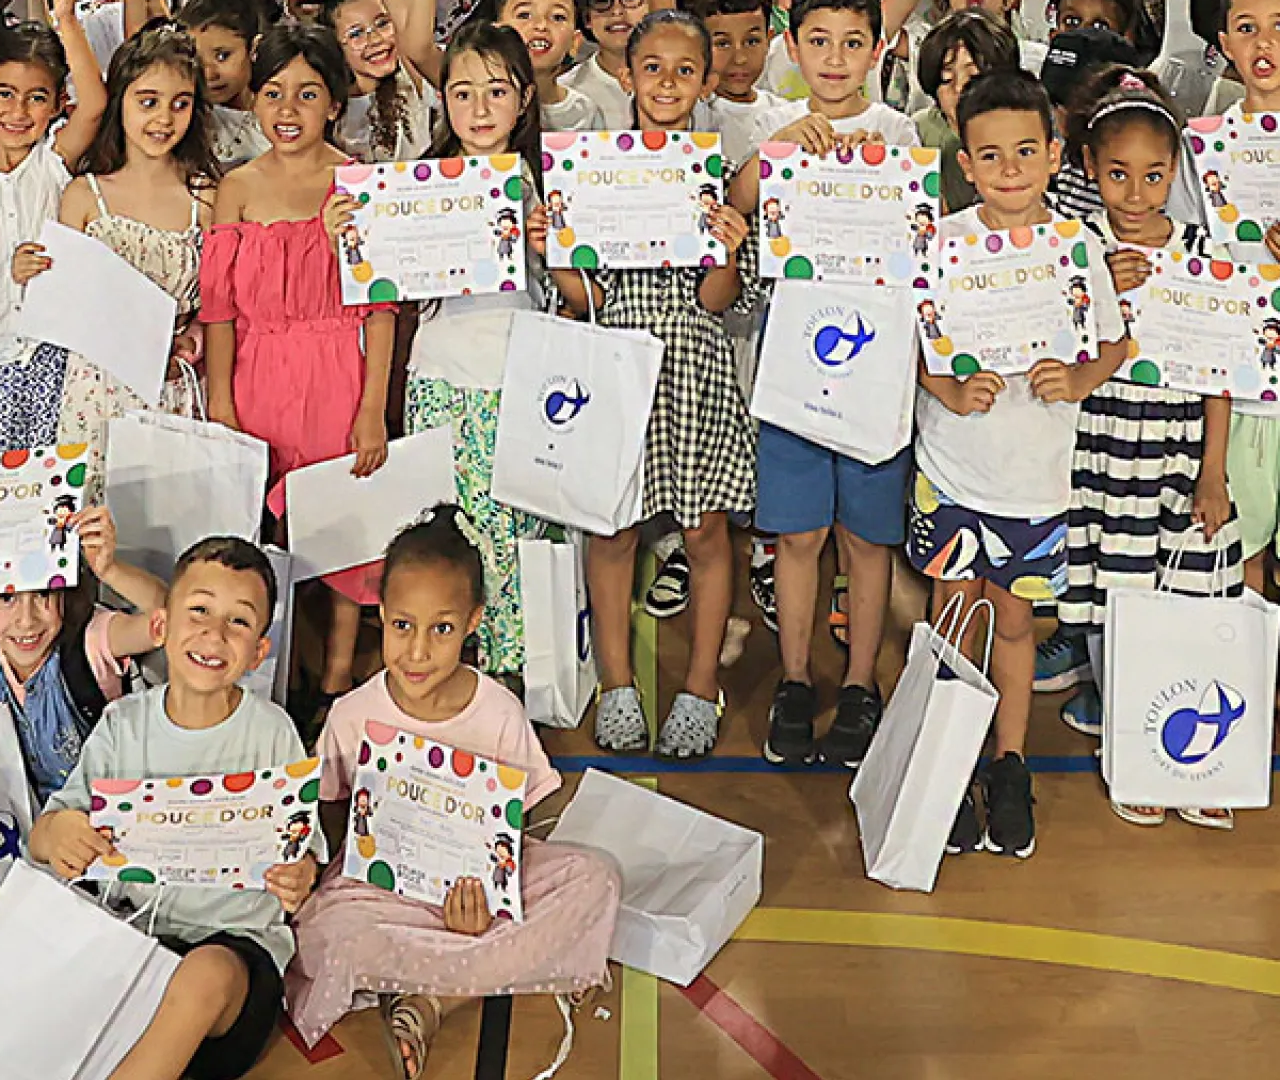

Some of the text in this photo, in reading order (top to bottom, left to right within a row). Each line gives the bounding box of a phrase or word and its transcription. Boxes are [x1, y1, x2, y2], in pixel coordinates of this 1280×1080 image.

[861, 183, 903, 201] D'OR
[374, 195, 484, 218] POUCE D'OR
[1015, 263, 1056, 284] D'OR
[1208, 296, 1250, 316] D'OR
[1143, 679, 1198, 735] TOULON
[387, 777, 485, 825] POUCE D'OR
[136, 805, 273, 824] POUCE D'OR
